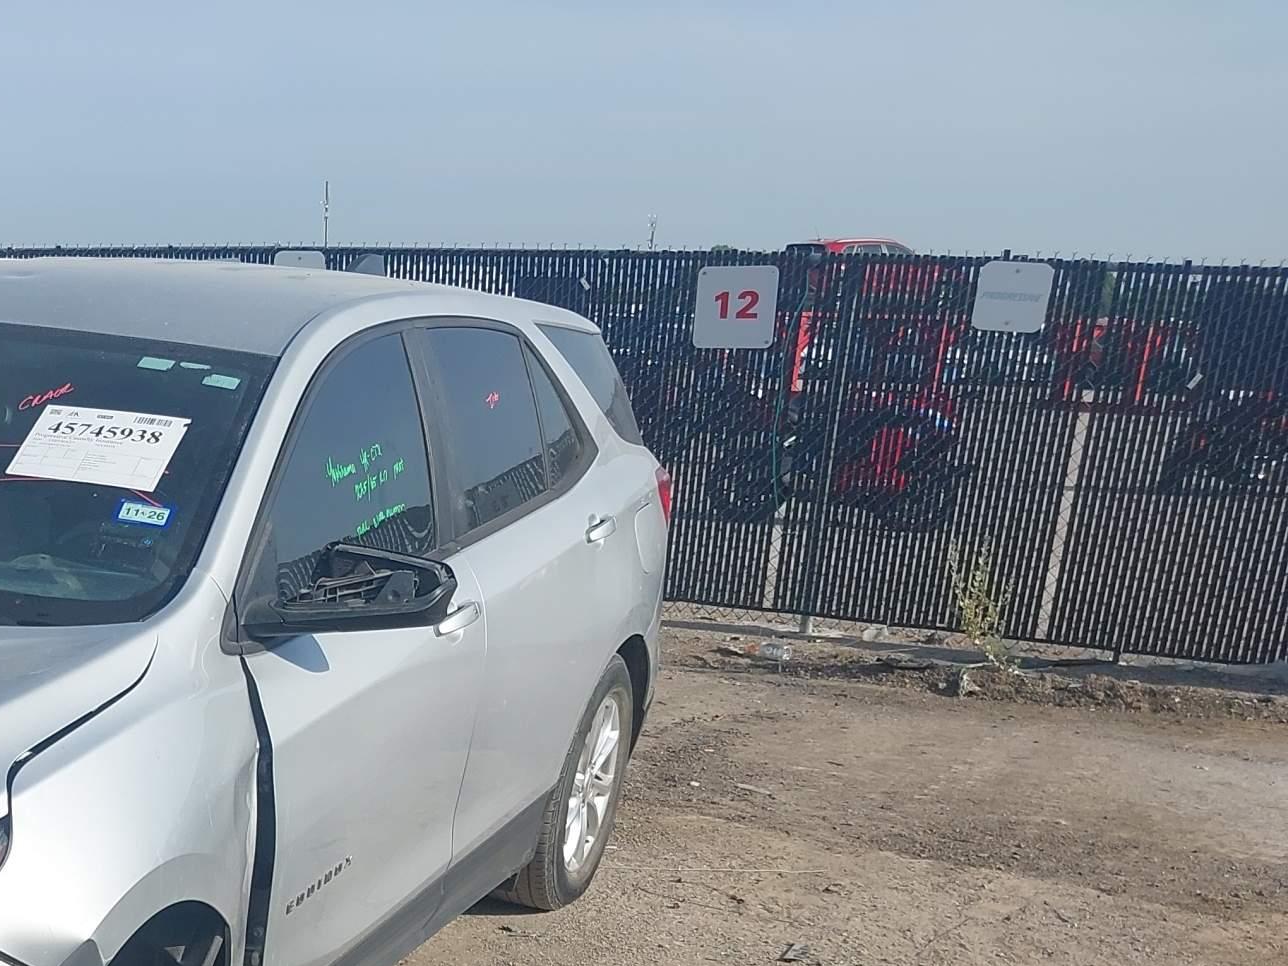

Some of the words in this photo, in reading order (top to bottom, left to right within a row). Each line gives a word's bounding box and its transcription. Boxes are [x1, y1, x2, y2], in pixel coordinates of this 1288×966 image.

[714, 290, 760, 320] 12
[48, 421, 163, 444] 45745938
[125, 507, 140, 517] 11
[147, 510, 166, 521] 26
